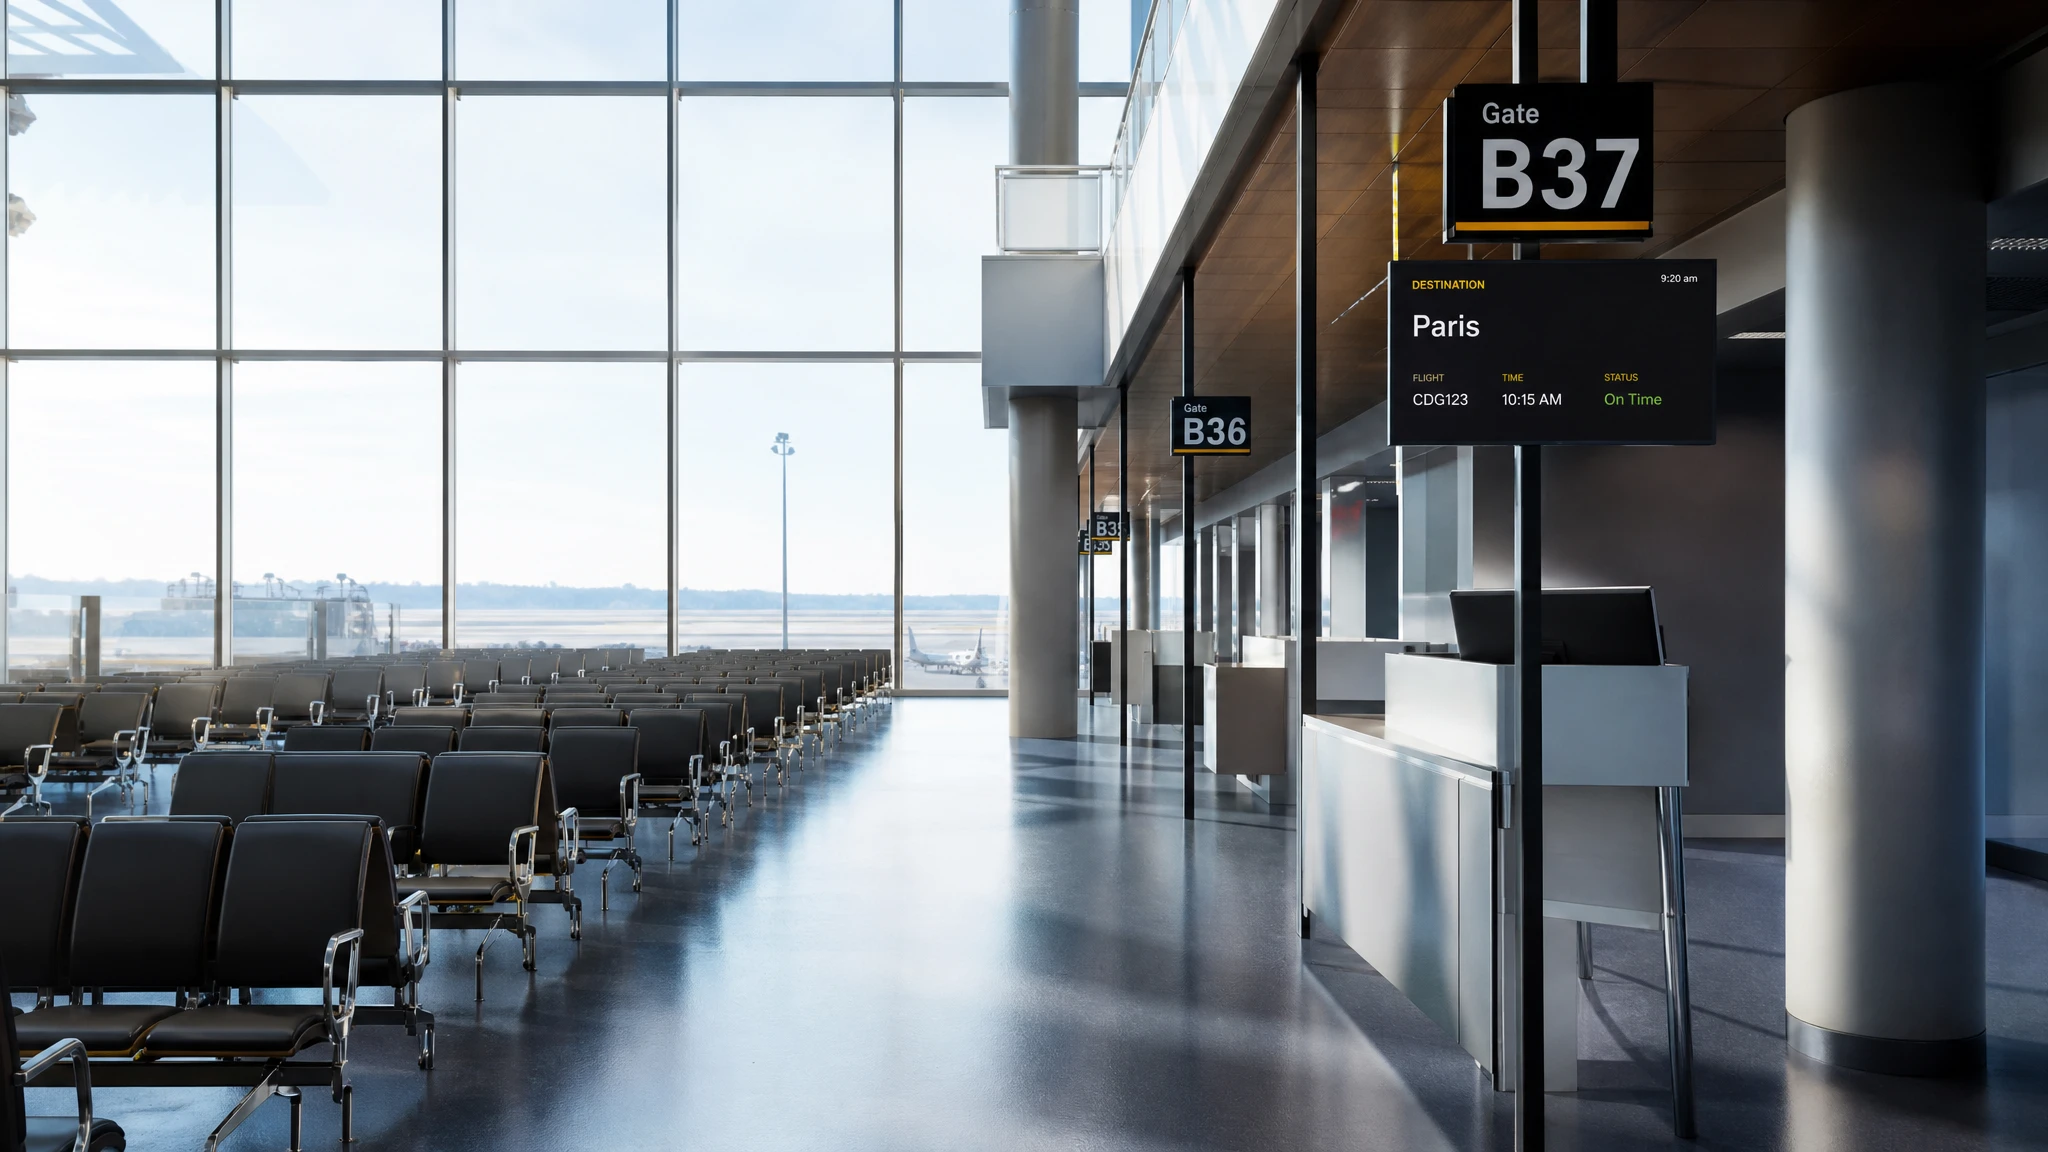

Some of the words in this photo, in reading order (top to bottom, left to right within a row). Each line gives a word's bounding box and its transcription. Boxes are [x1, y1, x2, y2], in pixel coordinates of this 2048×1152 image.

[1482, 102, 1540, 125] Gate
[1482, 137, 1640, 210] B37
[1412, 279, 1485, 290] DESTINATION
[1660, 274, 1681, 283] 9:20
[1682, 275, 1698, 283] am
[1413, 314, 1480, 337] Paris
[1412, 373, 1445, 382] FLIGHT
[1502, 373, 1524, 382] TIME
[1604, 373, 1639, 382] STATUS
[1412, 393, 1469, 406] CDG123
[1502, 393, 1536, 406] 10:15
[1539, 393, 1562, 406] AM
[1604, 393, 1624, 406] On
[1628, 393, 1662, 406] Time
[1183, 403, 1207, 413] Gate
[1184, 417, 1246, 445] B36
